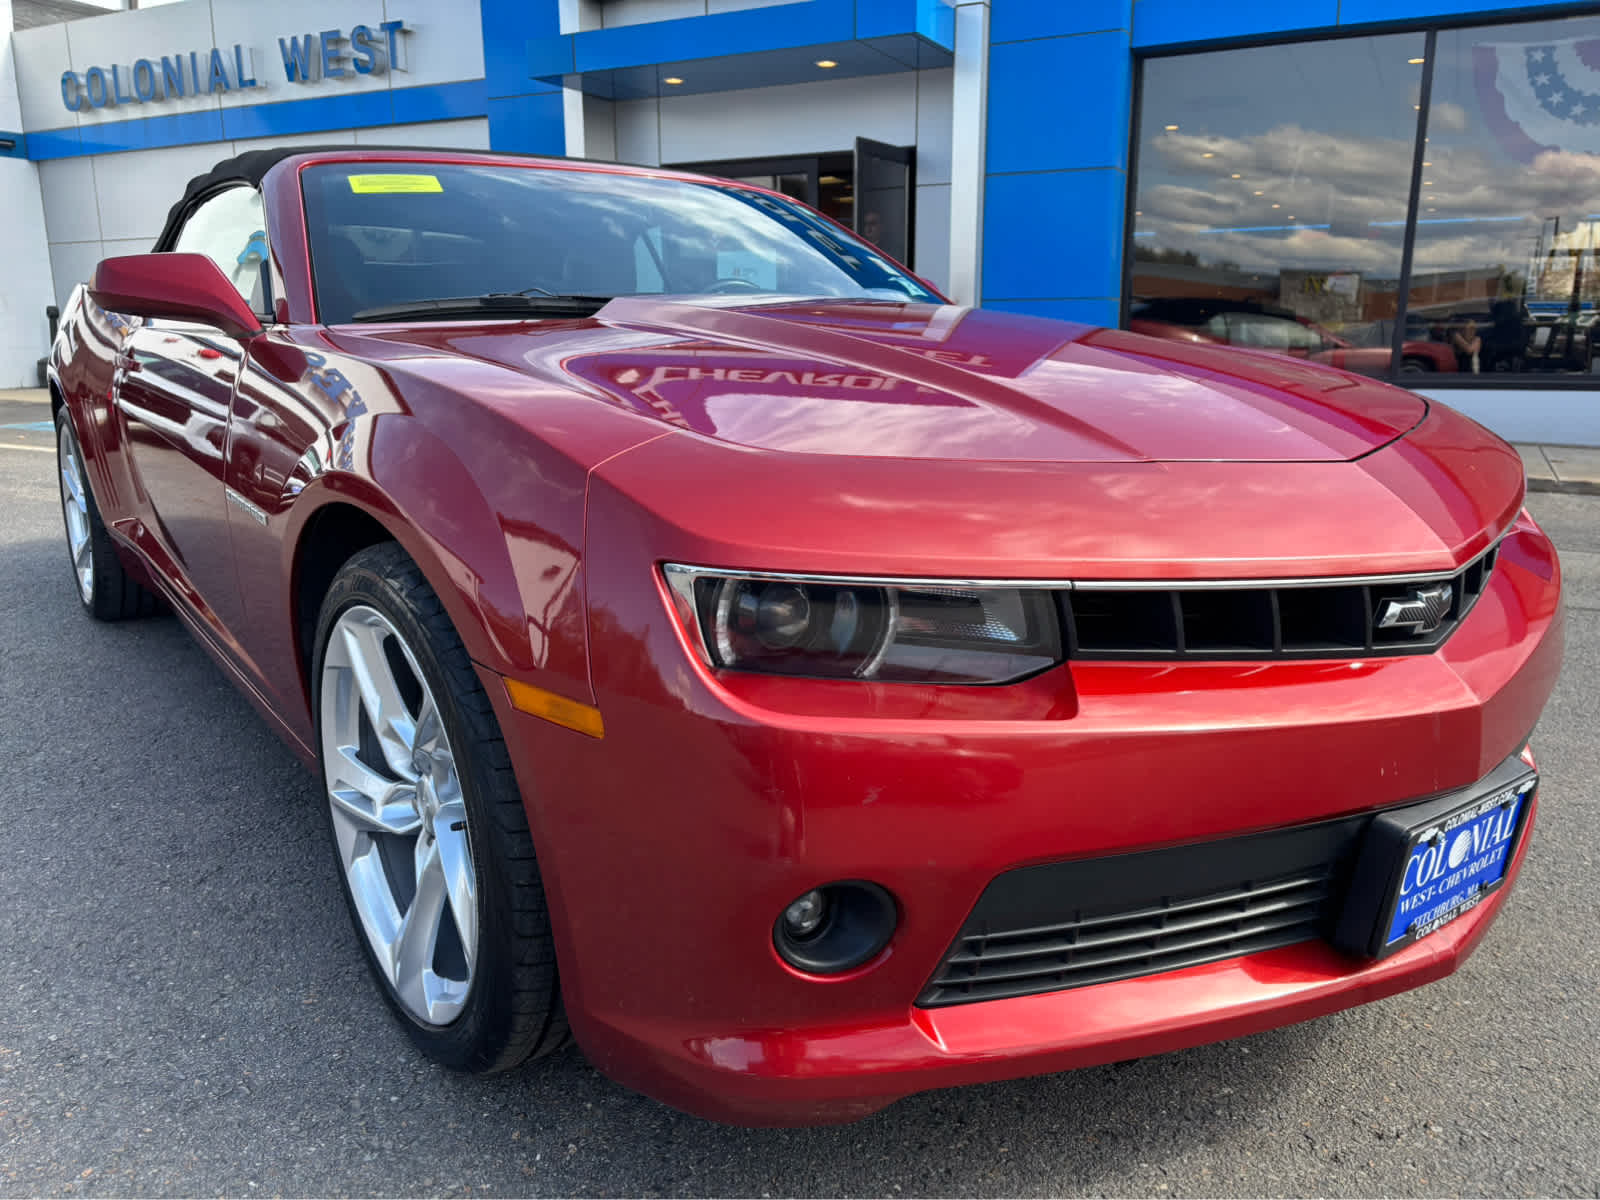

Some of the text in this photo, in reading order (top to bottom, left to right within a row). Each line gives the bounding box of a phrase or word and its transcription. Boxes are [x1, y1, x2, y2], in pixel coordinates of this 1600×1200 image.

[61, 18, 404, 112] COLONIAL WEST
[1399, 802, 1519, 896] COLONIAL
[1415, 895, 1482, 941] COLONIAL WEST
